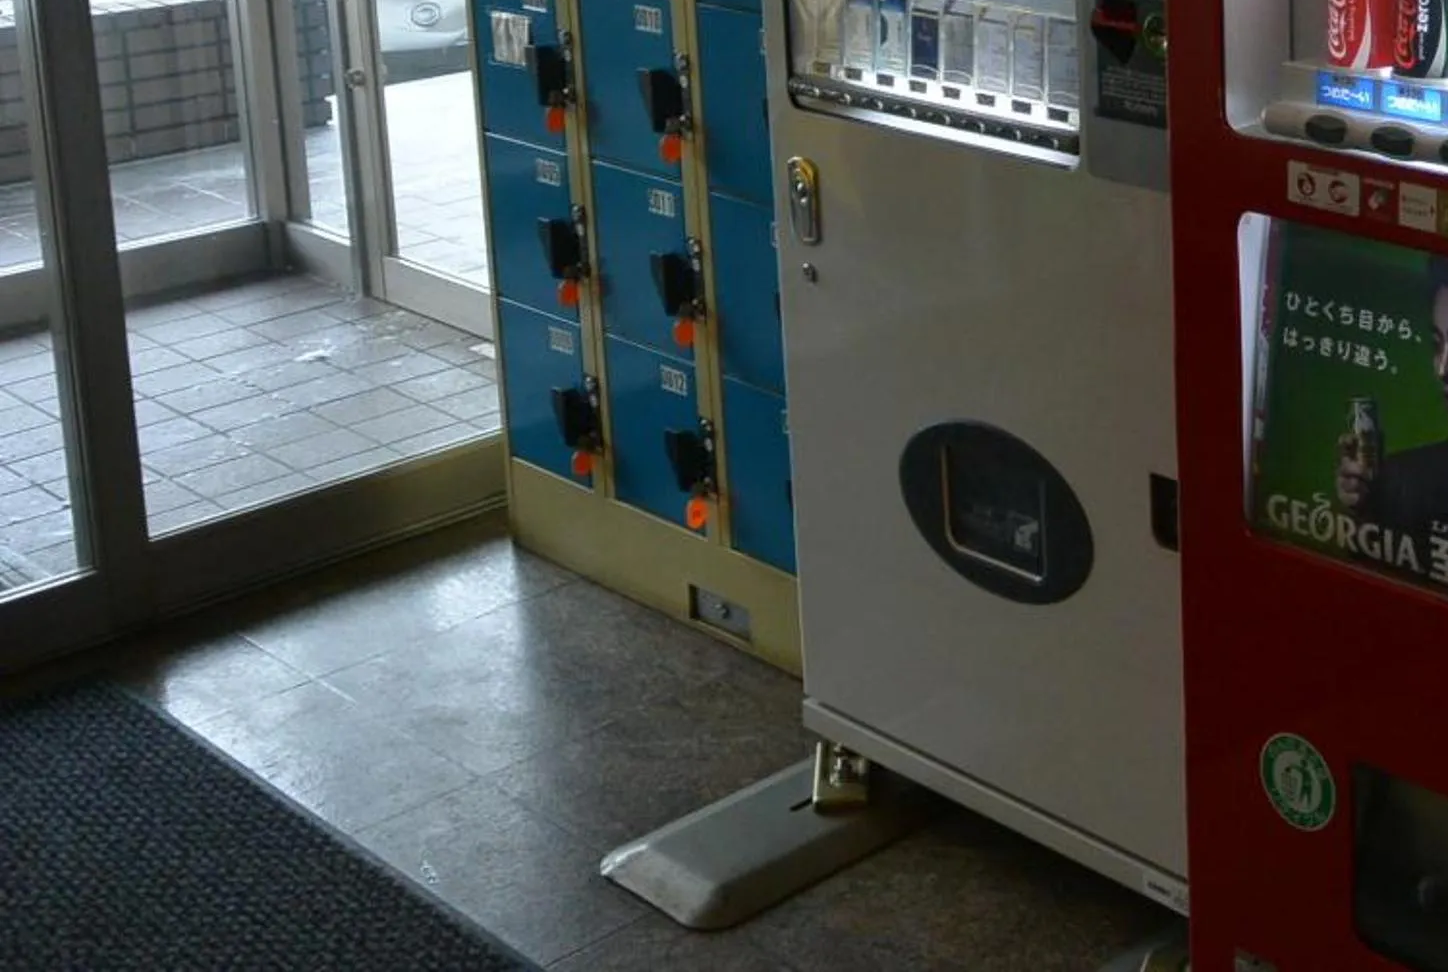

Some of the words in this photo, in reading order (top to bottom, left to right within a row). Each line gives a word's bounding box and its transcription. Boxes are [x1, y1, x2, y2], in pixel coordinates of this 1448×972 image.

[1285, 290, 1422, 343] ひとくち目から、
[1282, 327, 1398, 375] はっきり違う。
[1266, 491, 1425, 576] GEORGIA
